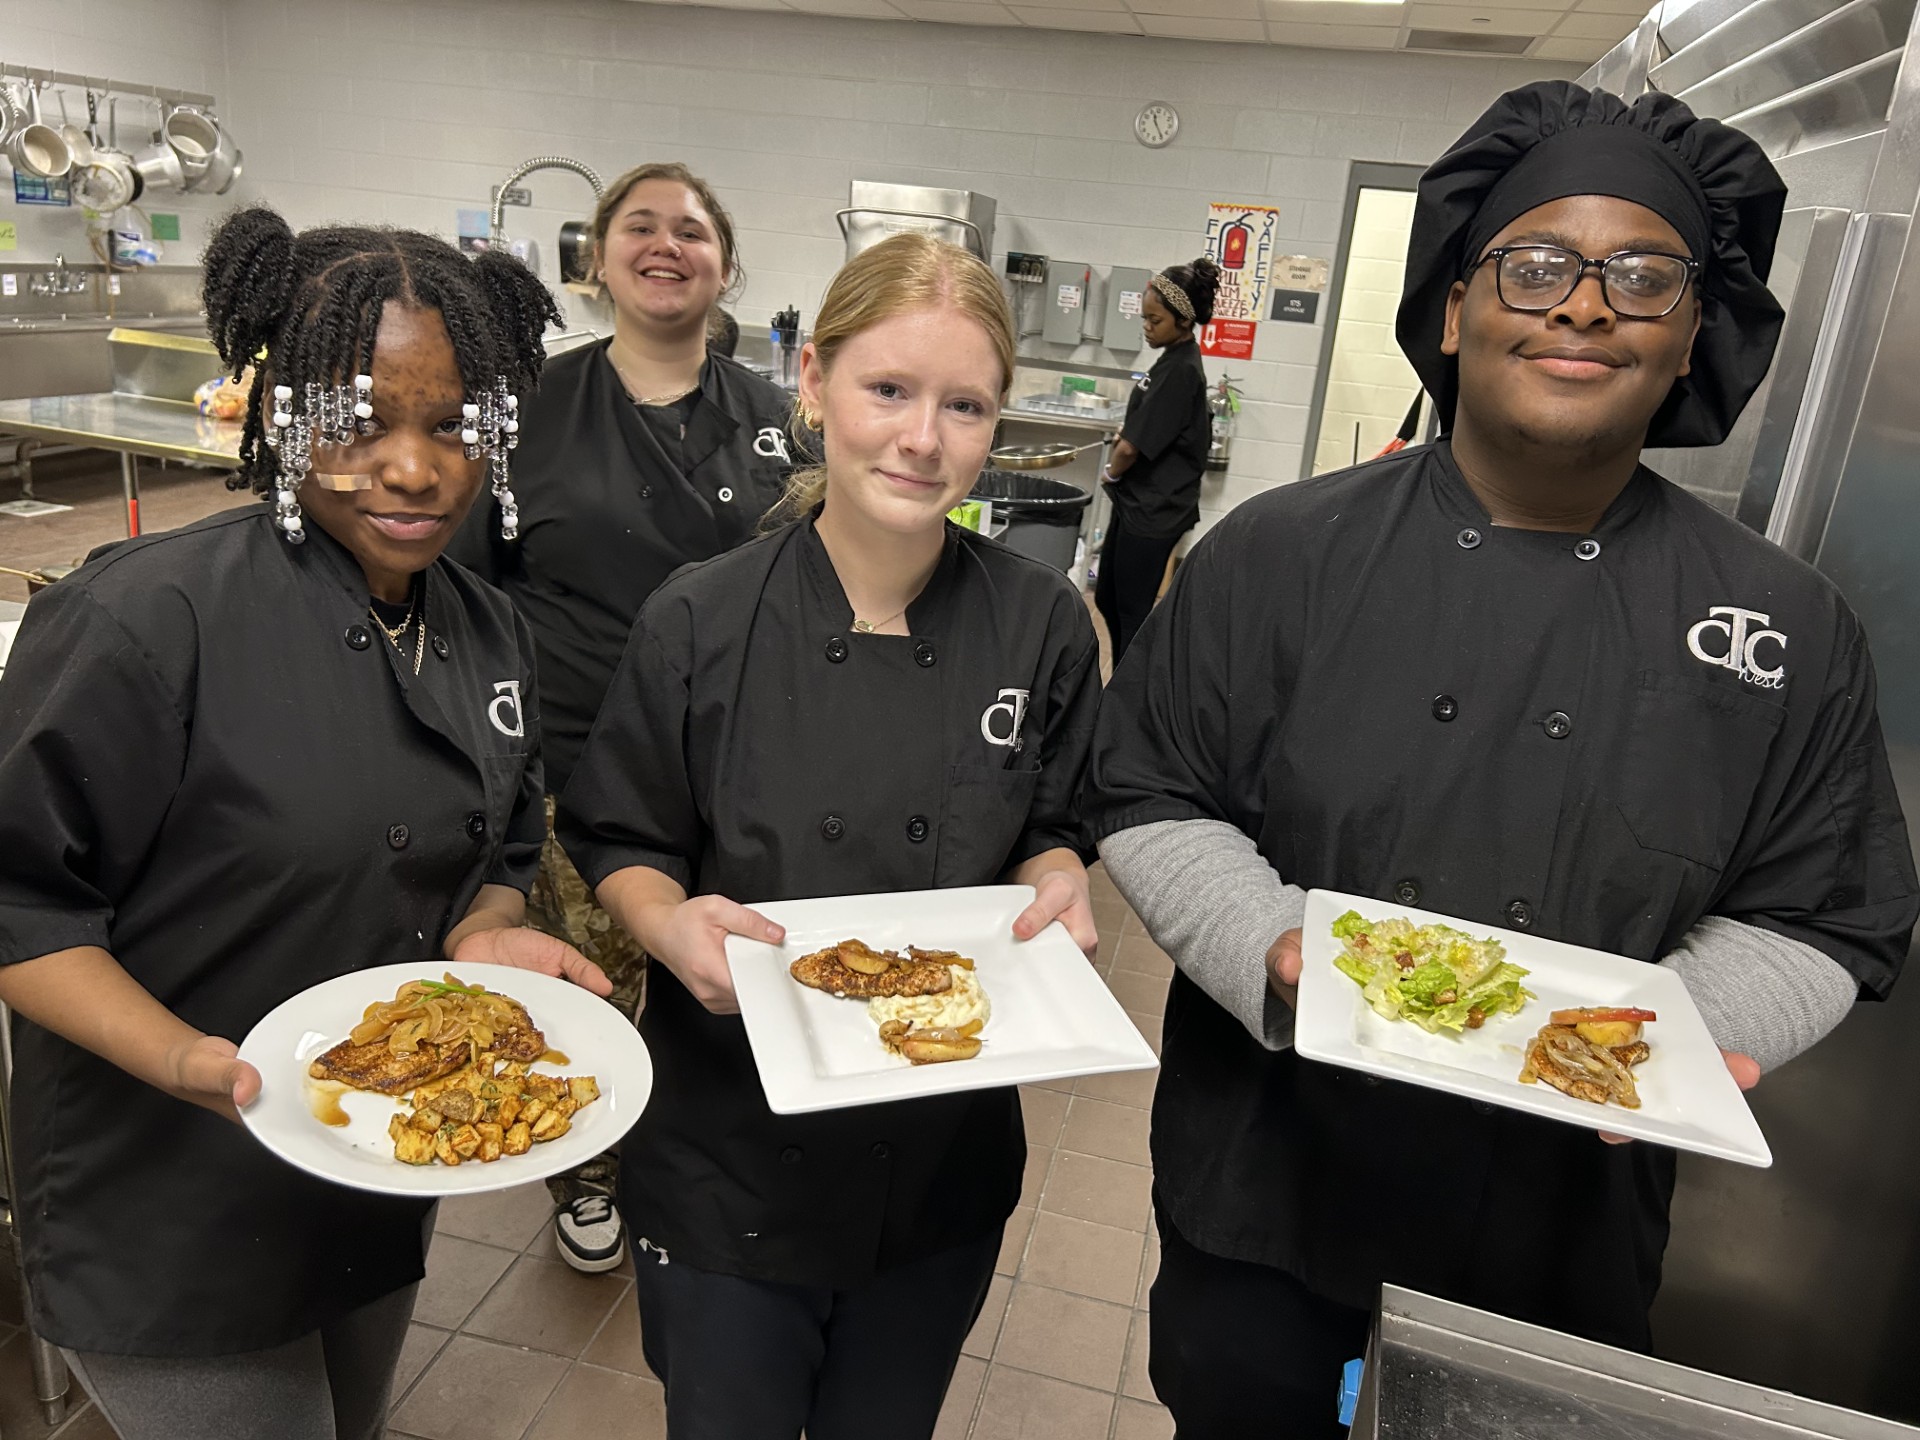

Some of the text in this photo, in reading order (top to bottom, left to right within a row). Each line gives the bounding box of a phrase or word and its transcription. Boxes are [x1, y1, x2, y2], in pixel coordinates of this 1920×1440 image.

[1205, 219, 1219, 261] FIR
[1251, 210, 1279, 310] SAFETY
[1215, 285, 1240, 300] AIM
[1686, 606, 1788, 678] CTC
[488, 680, 525, 737] CT
[980, 688, 1031, 746] CT
